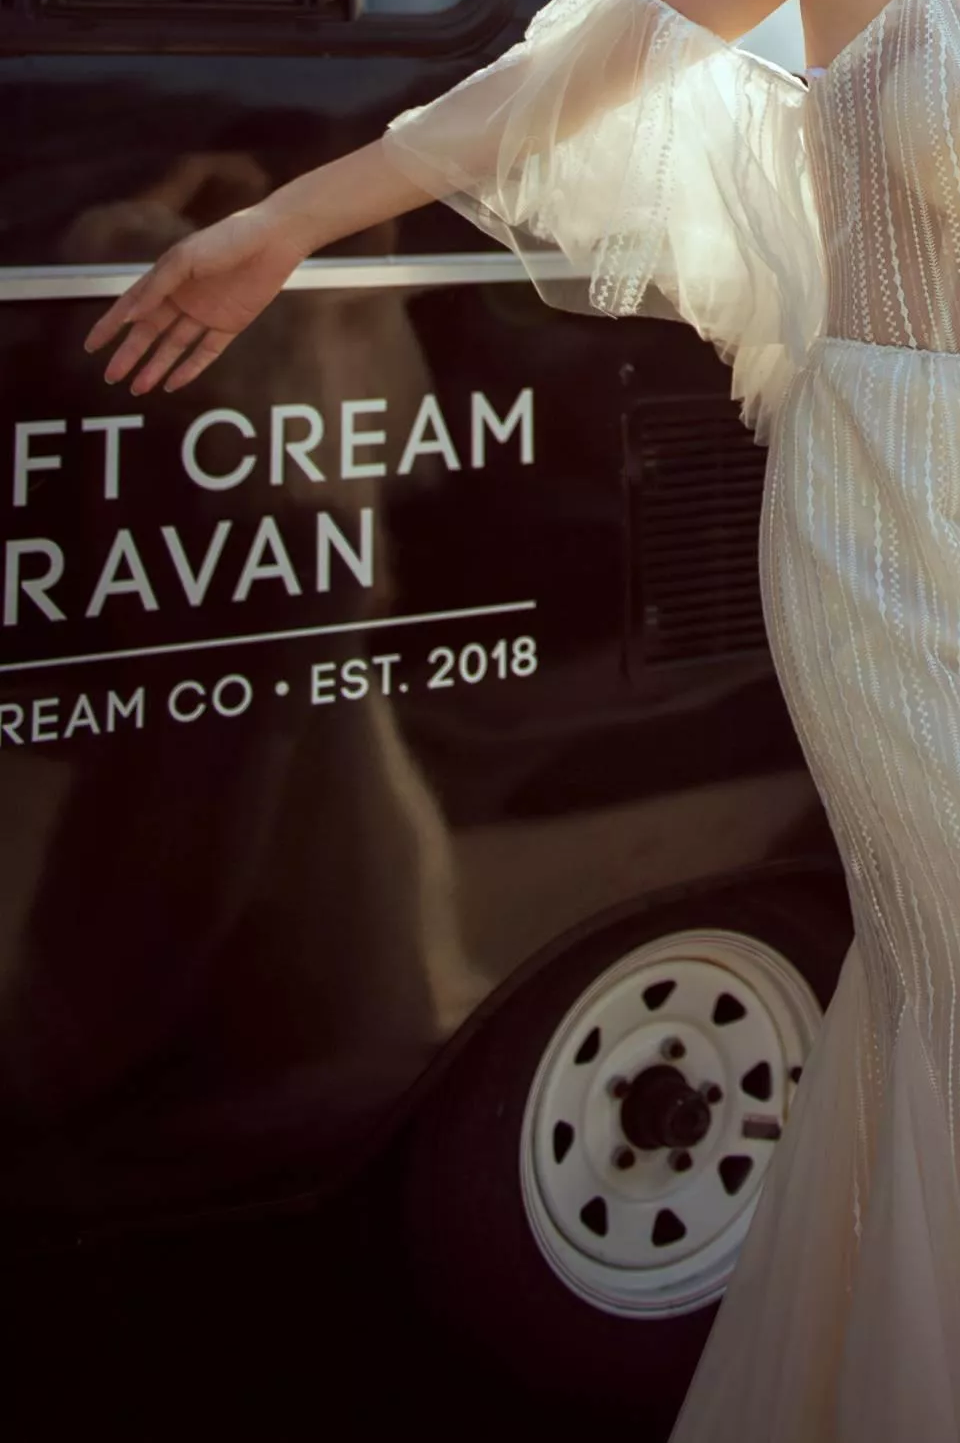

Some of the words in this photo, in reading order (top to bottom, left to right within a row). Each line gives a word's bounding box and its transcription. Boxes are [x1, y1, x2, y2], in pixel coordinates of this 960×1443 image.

[13, 414, 144, 507] FT
[182, 388, 534, 490] CREAM
[3, 508, 374, 626] RAVAN
[168, 674, 253, 723] CO
[311, 654, 409, 705] EST.
[426, 635, 538, 689] 2018
